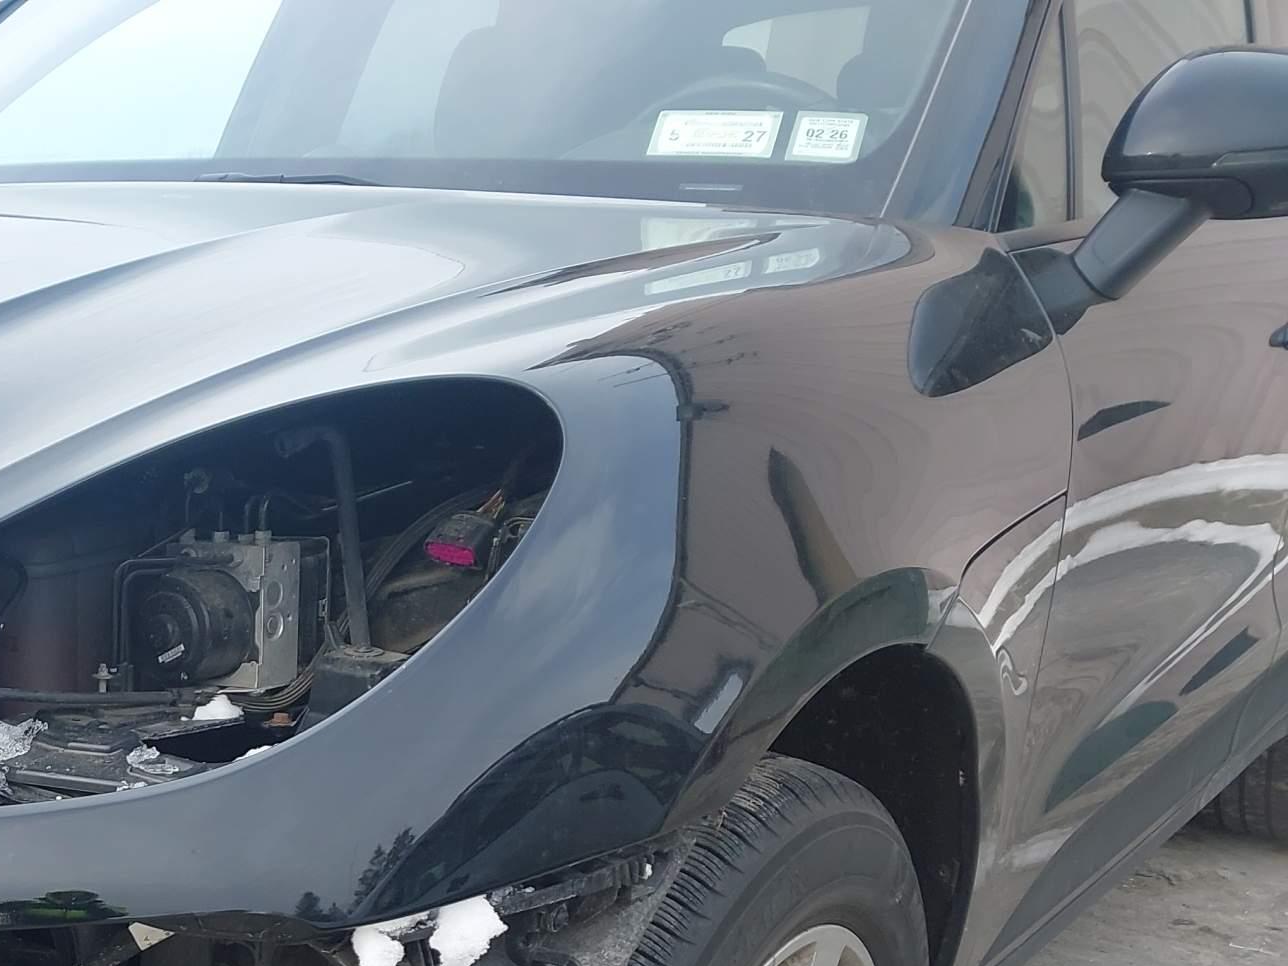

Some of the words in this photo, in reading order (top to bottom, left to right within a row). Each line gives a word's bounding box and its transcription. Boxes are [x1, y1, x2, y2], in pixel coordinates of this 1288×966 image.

[741, 130, 768, 143] 27
[806, 128, 825, 139] 02
[829, 129, 849, 140] 26
